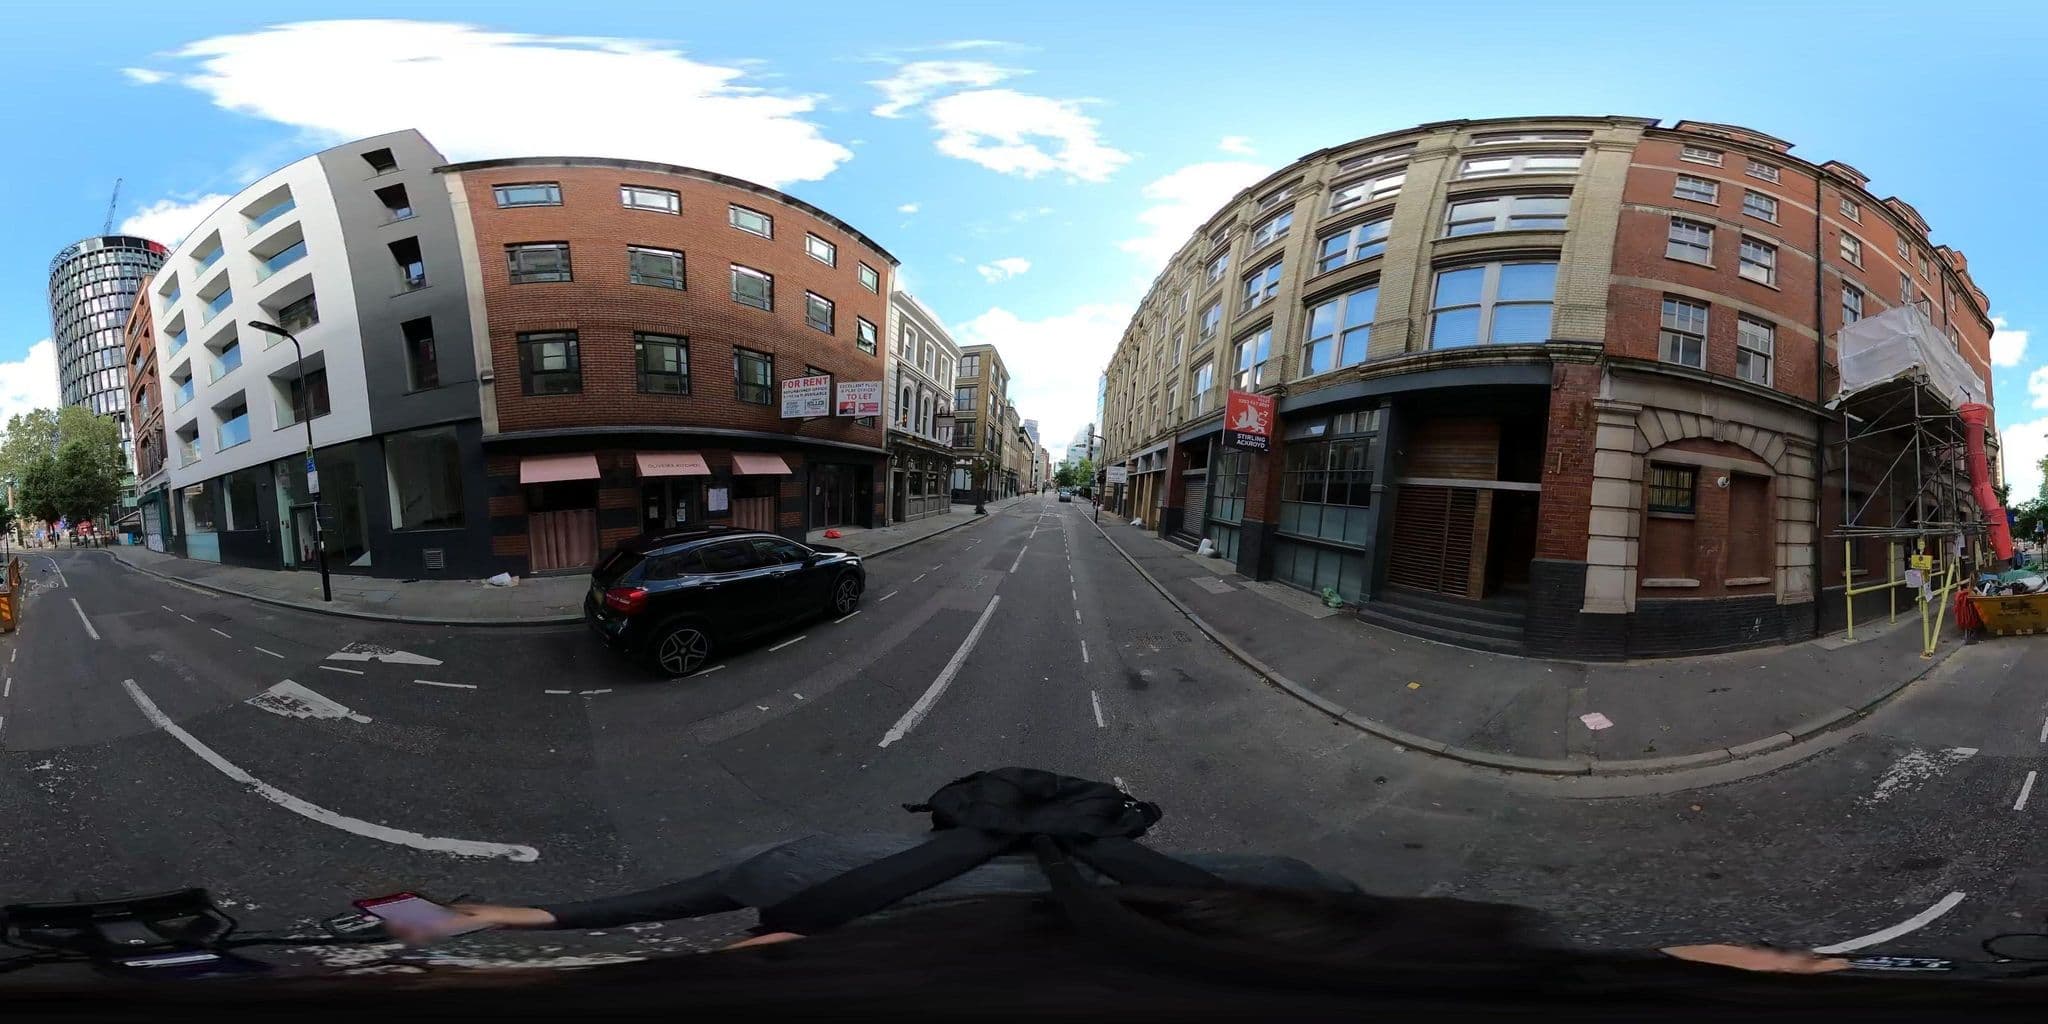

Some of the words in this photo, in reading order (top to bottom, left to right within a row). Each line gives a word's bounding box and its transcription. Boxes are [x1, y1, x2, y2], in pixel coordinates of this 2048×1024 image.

[783, 380, 800, 389] FOR
[803, 376, 829, 386] RENT
[1237, 433, 1266, 443] STIRLING
[1236, 439, 1265, 449] ACKROYD
